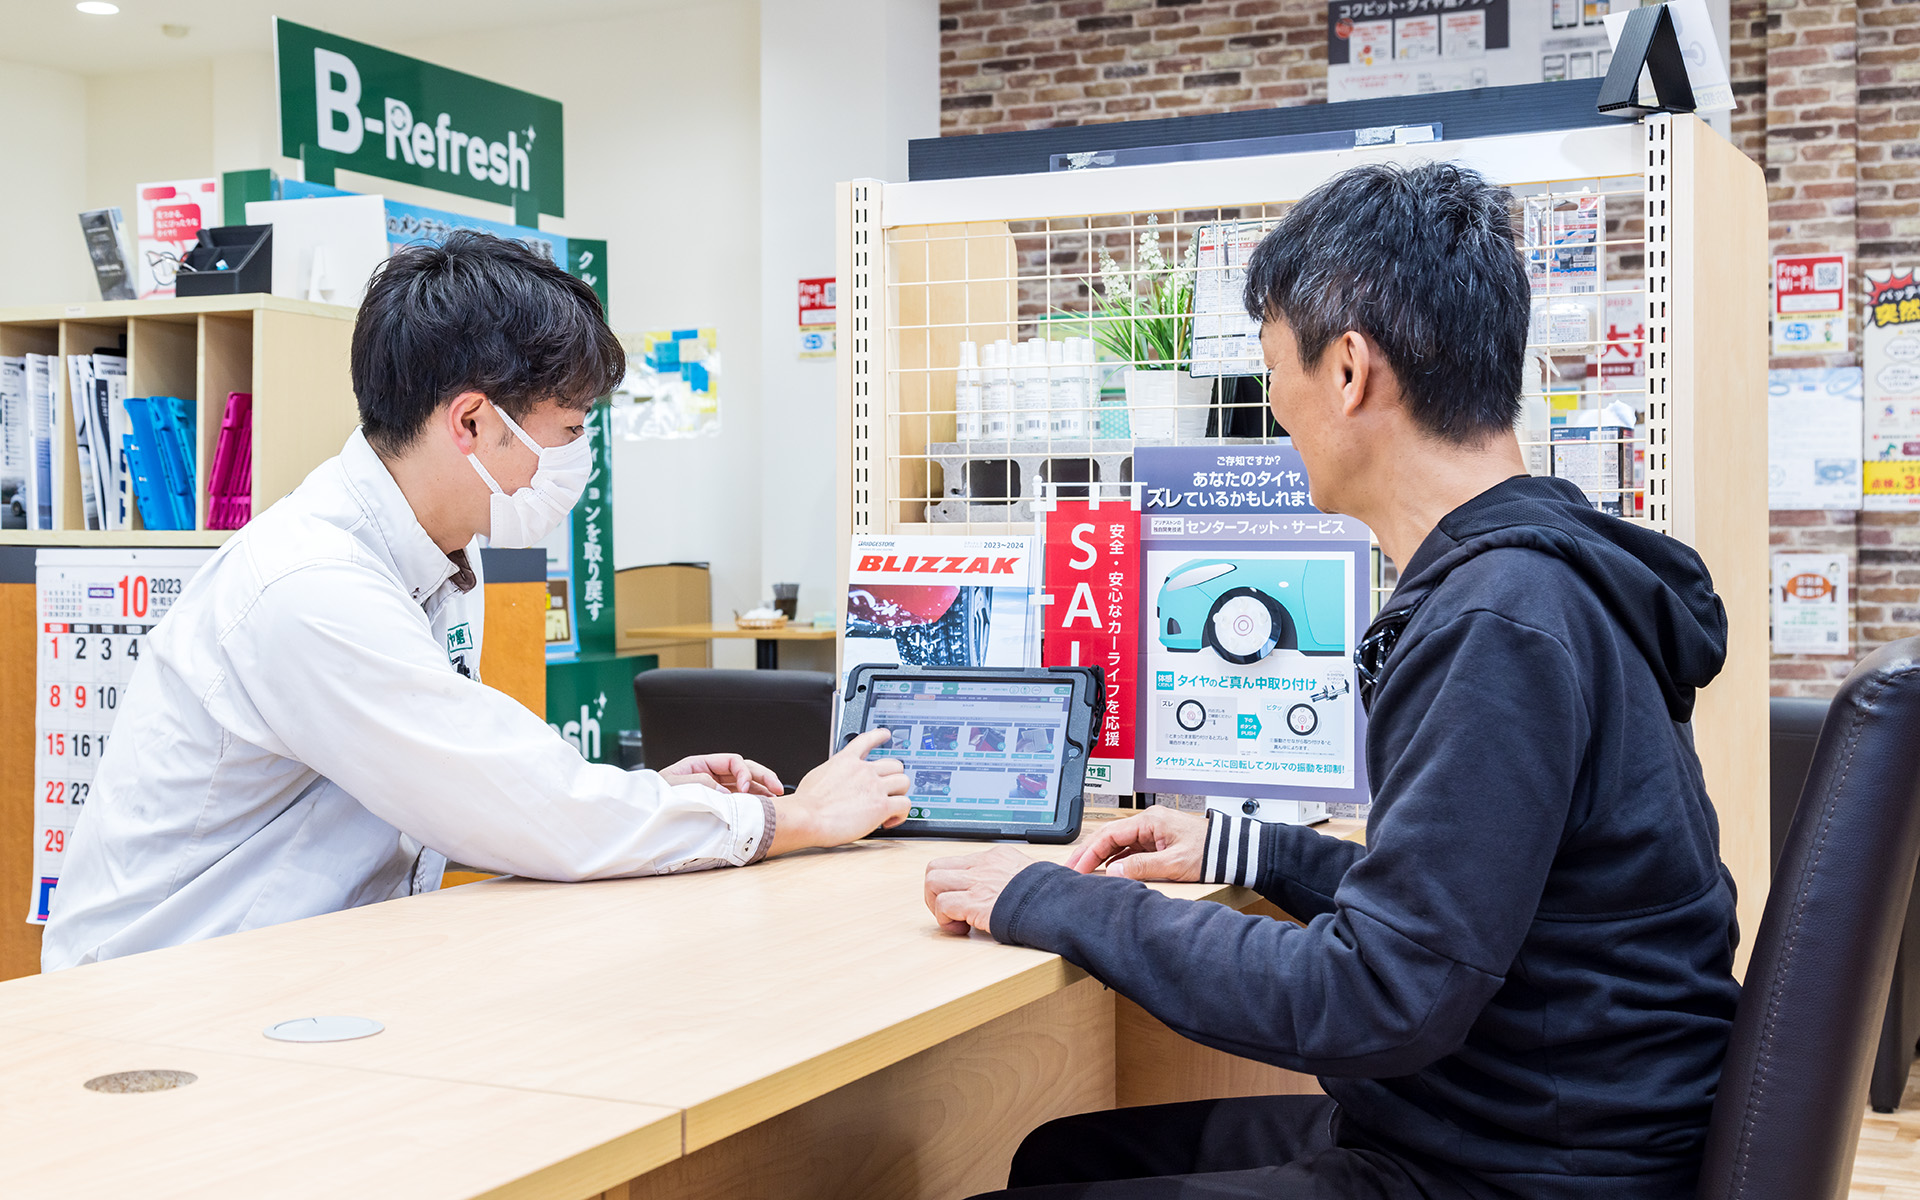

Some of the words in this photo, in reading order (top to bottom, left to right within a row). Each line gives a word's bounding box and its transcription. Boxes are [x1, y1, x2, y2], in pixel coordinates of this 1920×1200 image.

[314, 47, 530, 192] B-Refresh
[1778, 262, 1808, 278] Free
[1216, 455, 1281, 467] ご存知ですか?
[1193, 470, 1305, 488] あなたのタイヤ、
[1186, 519, 1346, 535] センターフィット・サービス
[857, 555, 1021, 574] BLIZZAK
[118, 575, 149, 618] 10
[150, 578, 182, 594] 2023
[1105, 523, 1125, 747] 安全・安心なカーライフを応援
[51, 636, 59, 659] 1
[75, 637, 87, 660] 2
[101, 638, 112, 660] 3
[127, 639, 139, 661] 4
[1157, 674, 1173, 682] 体感
[1177, 674, 1318, 691] タイヤのど真ん中取り付け
[50, 684, 61, 707] 8
[75, 685, 87, 708] 9
[98, 686, 117, 709] 10
[47, 733, 65, 756] 15
[72, 734, 91, 757] 16
[45, 781, 65, 804] 22
[71, 783, 90, 805] 23
[44, 829, 65, 852] 29
